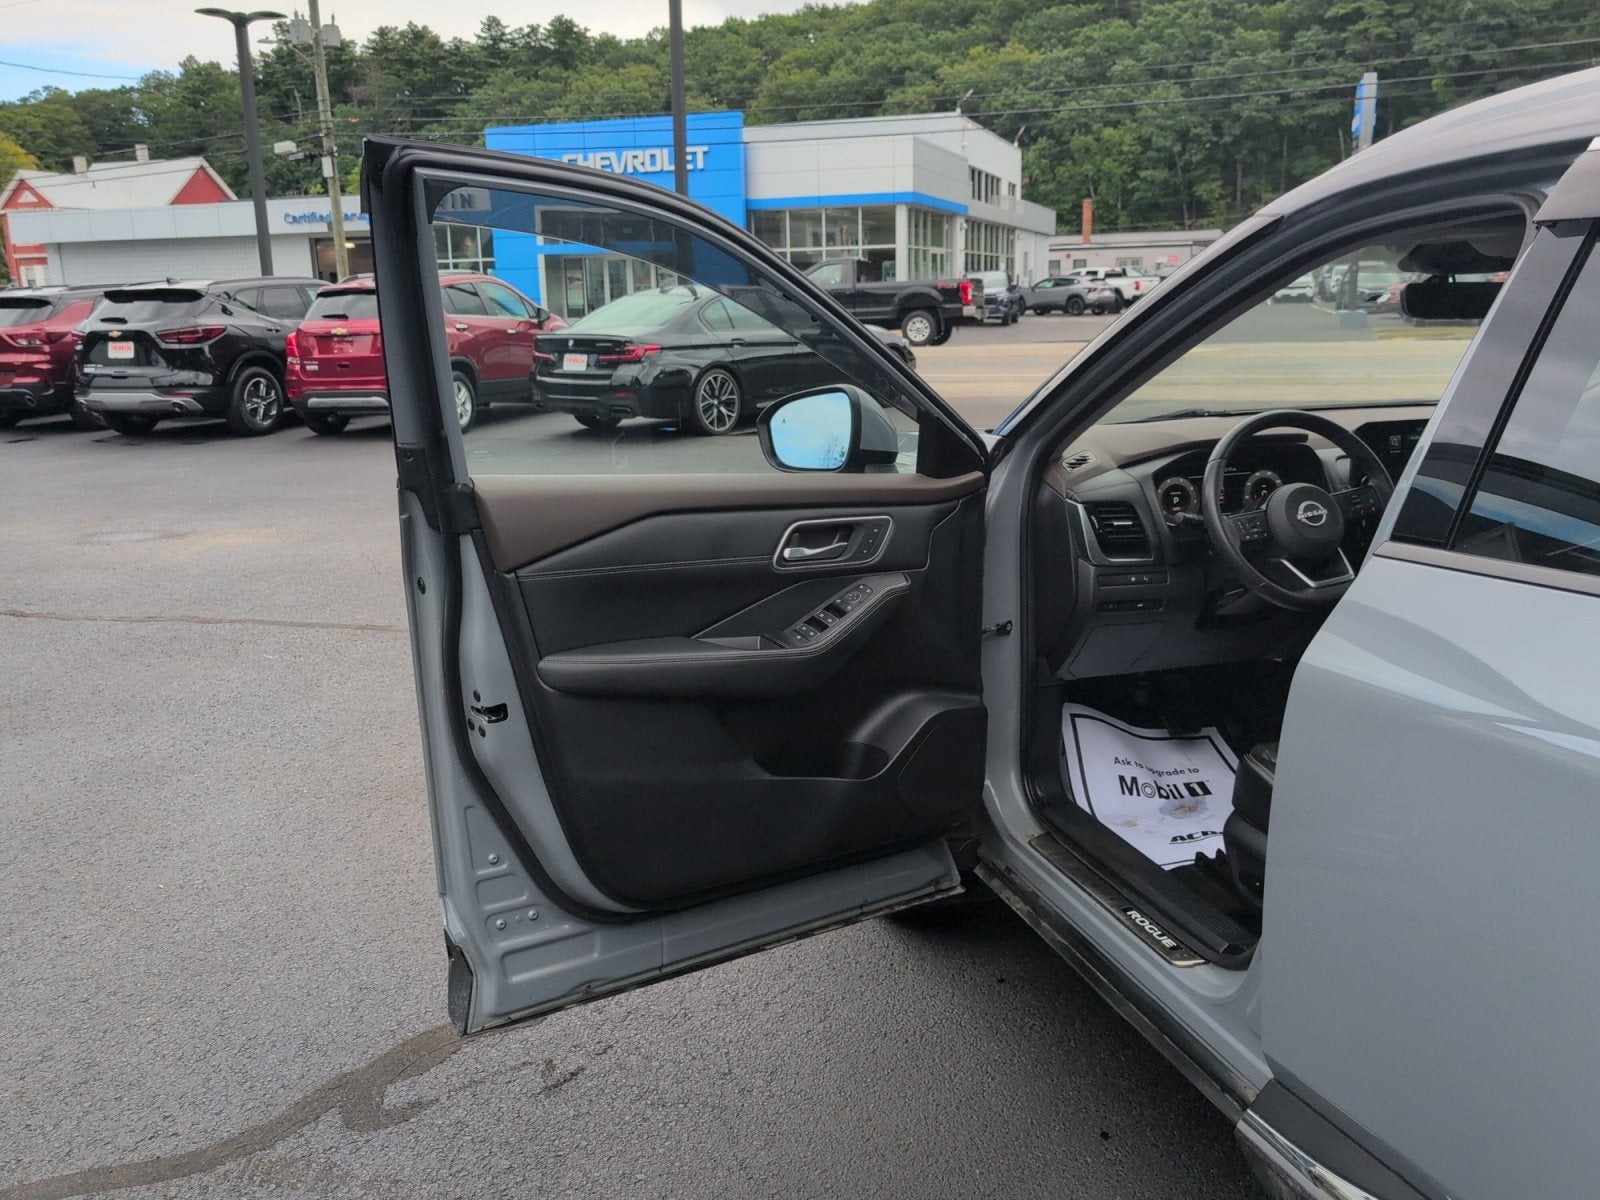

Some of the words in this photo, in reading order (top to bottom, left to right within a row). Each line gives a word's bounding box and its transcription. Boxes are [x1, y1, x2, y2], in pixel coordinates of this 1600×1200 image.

[284, 212, 332, 224] Certified
[111, 343, 132, 352] IRWIN
[1296, 509, 1328, 520] NISSAN
[1114, 756, 1132, 767] Ask
[1118, 775, 1185, 800] Mobil
[1126, 910, 1177, 948] ROGUE
